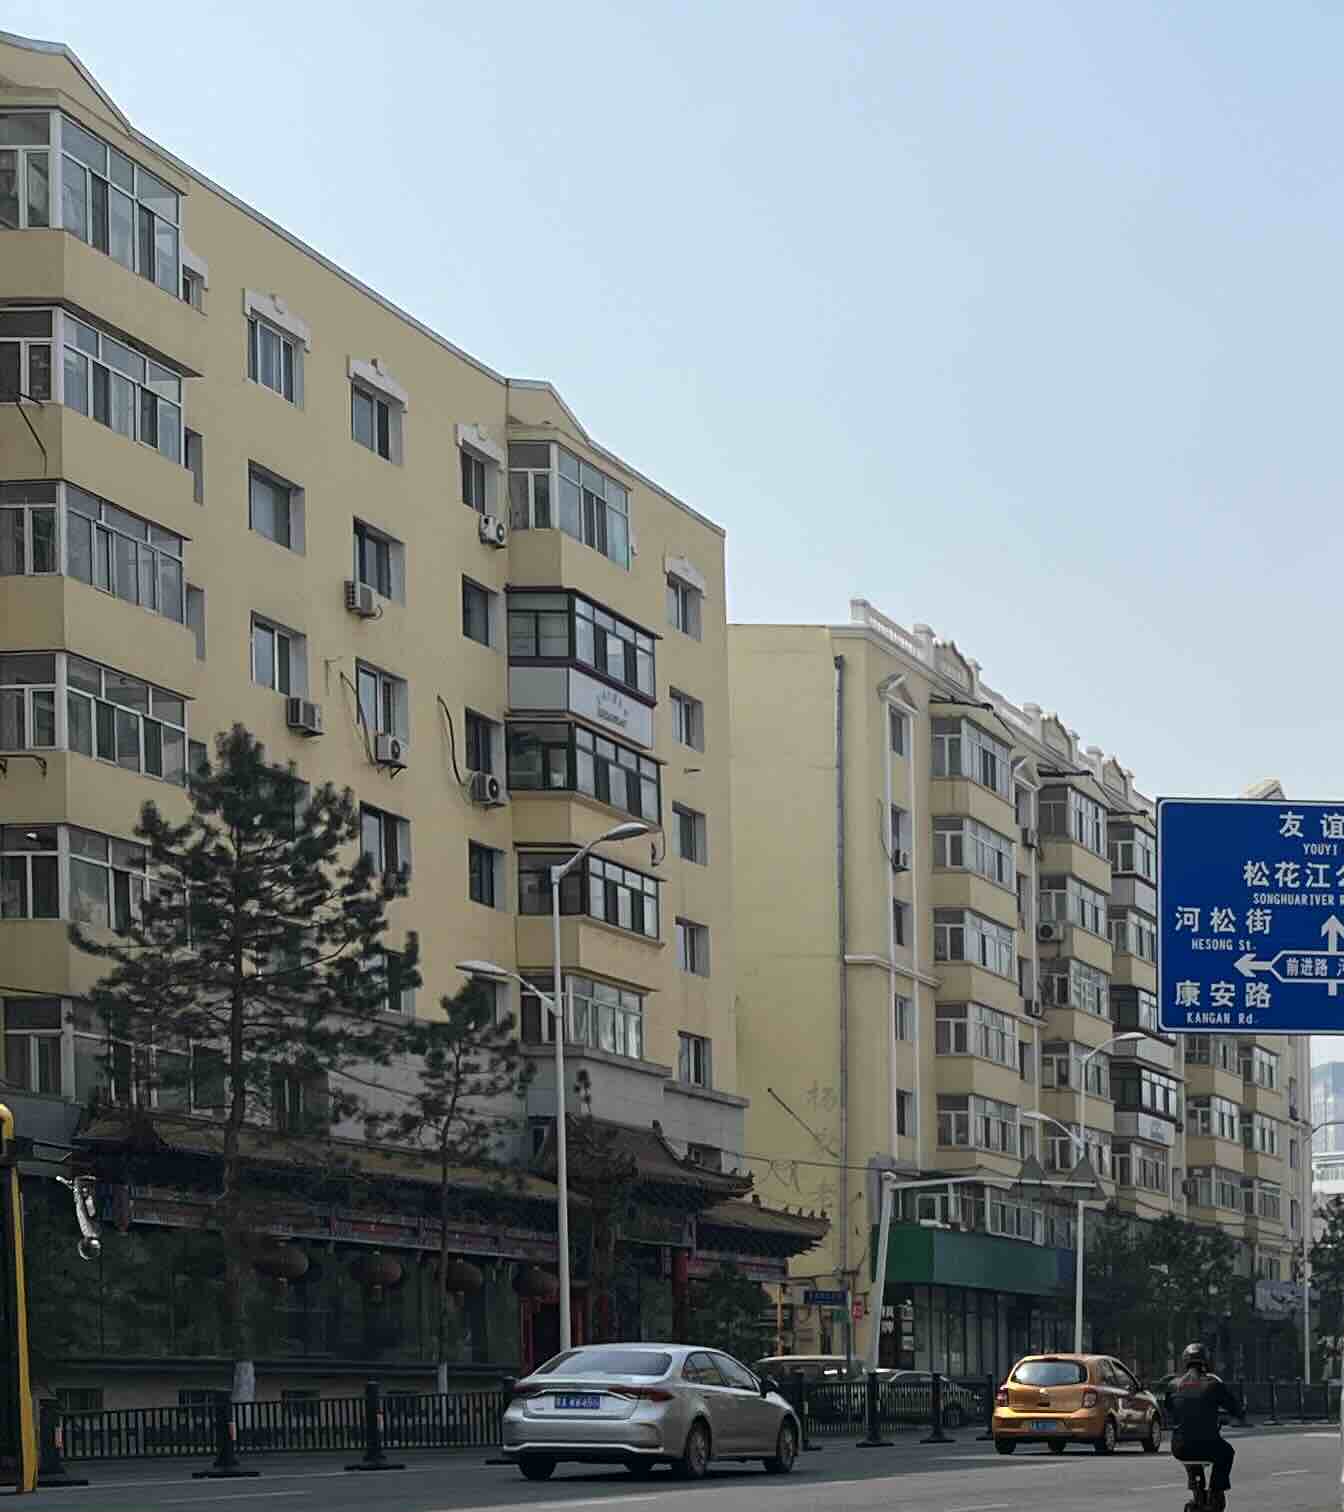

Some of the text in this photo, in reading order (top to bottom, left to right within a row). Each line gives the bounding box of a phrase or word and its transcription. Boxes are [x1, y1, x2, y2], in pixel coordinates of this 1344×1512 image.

[1303, 843, 1338, 856] YOUYI
[1253, 893, 1335, 906] SONGHUARIVER
[1175, 906, 1272, 935] 河松街
[1191, 938, 1257, 951] HESONG St.
[1286, 957, 1329, 978] 前进路
[1175, 980, 1272, 1008] 康安路
[1186, 1012, 1231, 1025] KANGAN
